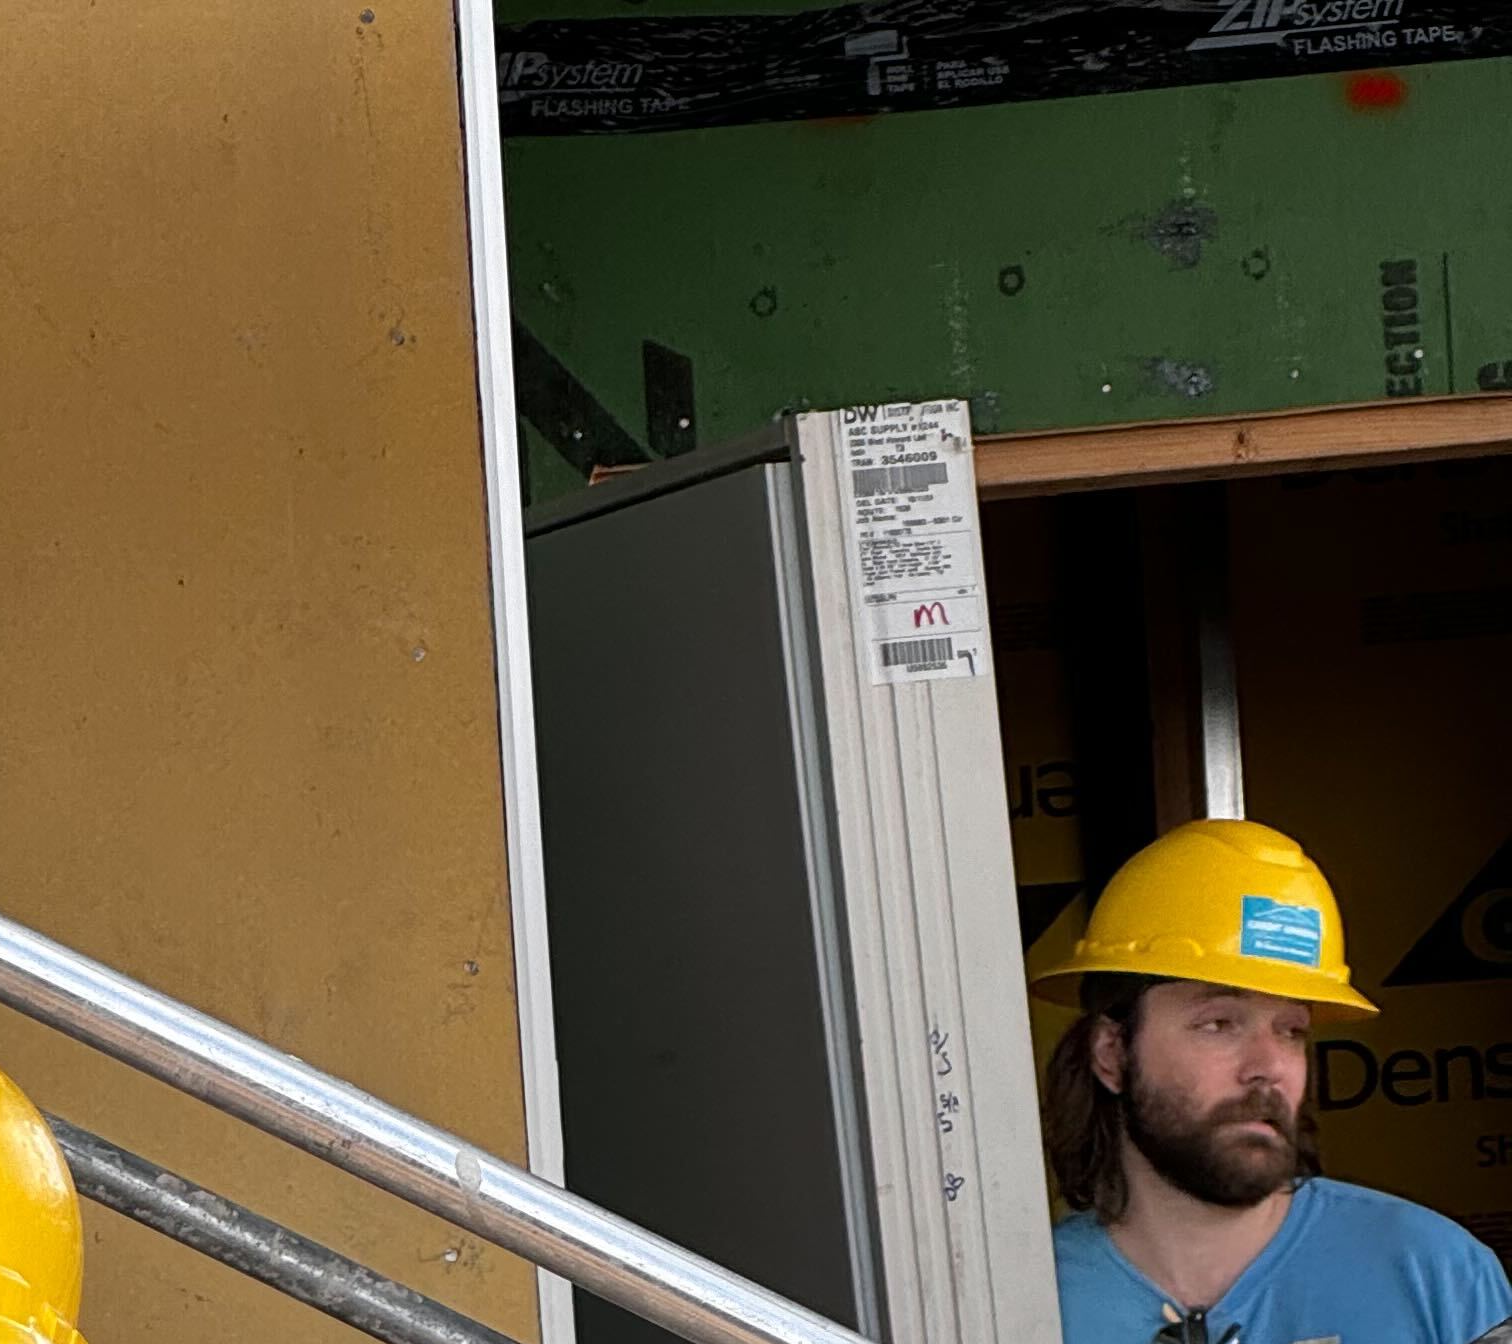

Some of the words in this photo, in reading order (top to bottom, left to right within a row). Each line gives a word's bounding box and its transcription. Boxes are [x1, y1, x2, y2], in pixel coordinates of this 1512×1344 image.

[1293, 29, 1397, 56] FLASHING
[1402, 24, 1457, 45] TAPE
[530, 97, 634, 118] FLASHING
